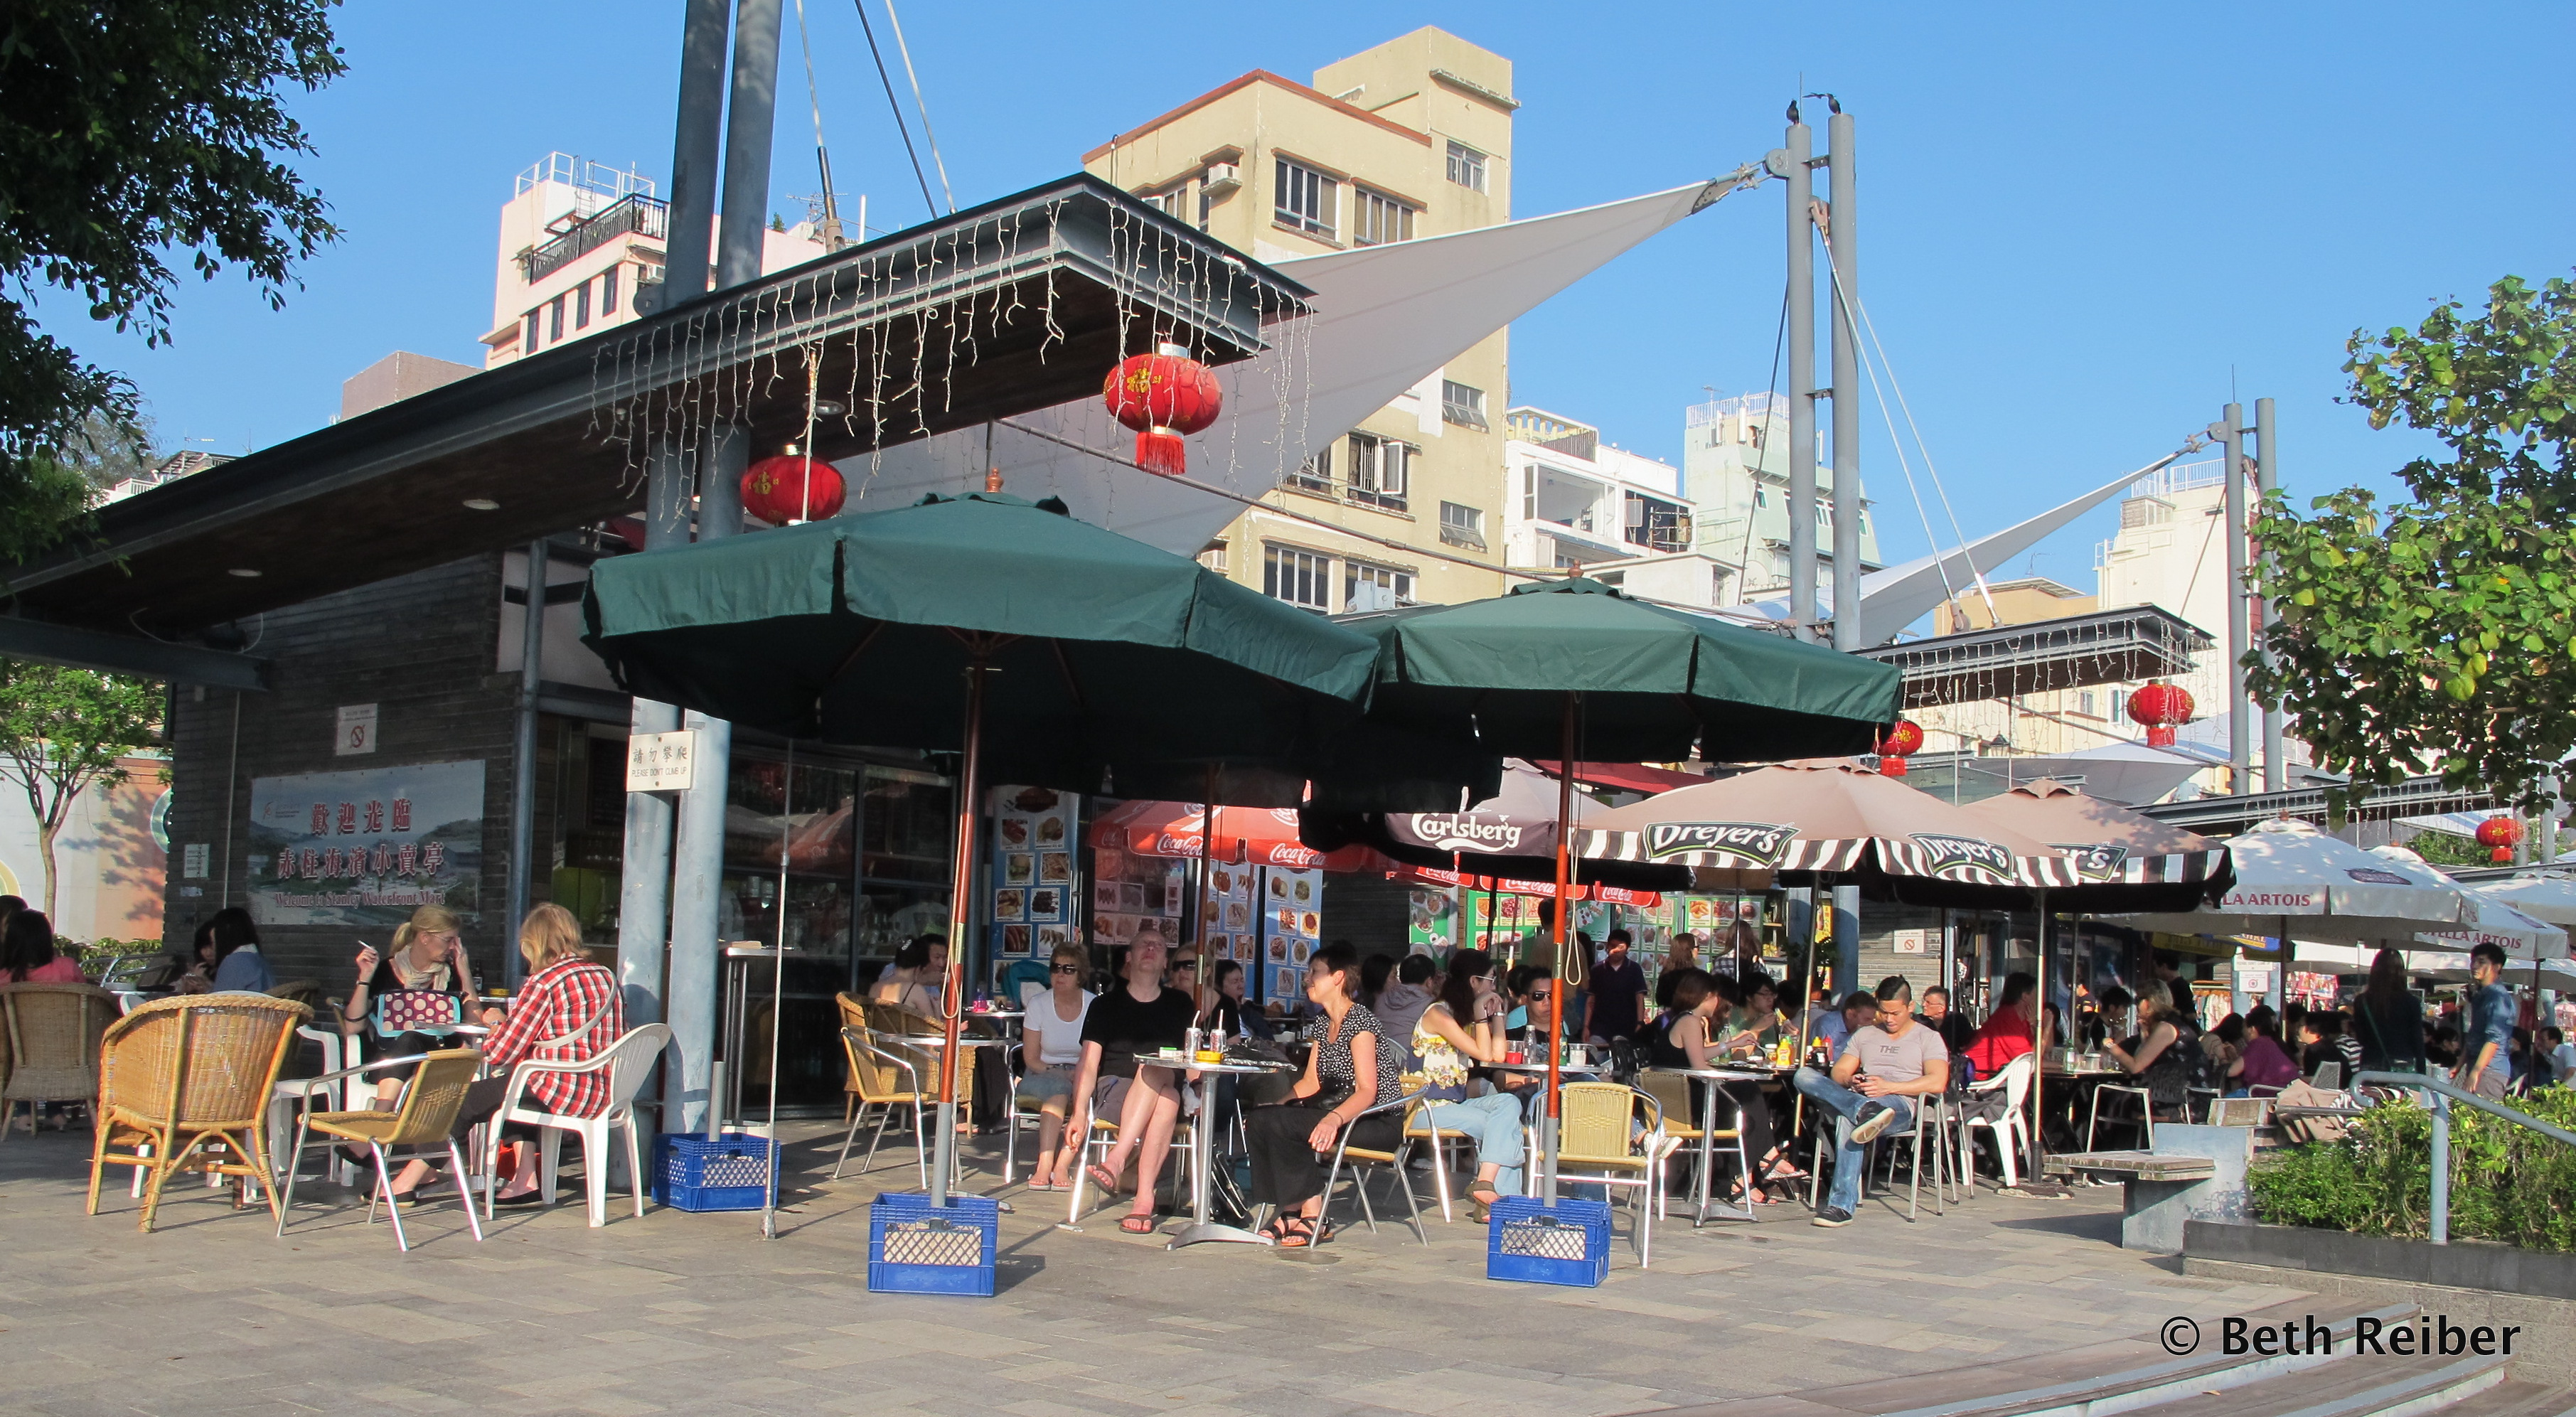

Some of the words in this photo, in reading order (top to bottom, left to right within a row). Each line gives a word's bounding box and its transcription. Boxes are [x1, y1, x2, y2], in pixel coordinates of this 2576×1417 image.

[633, 746, 688, 764] 請勿攀爬
[631, 769, 648, 777] PLEASE
[666, 767, 678, 776] CLIMB
[311, 798, 412, 835] 歡迎光臨
[1411, 813, 1522, 851] Carlsberg
[1654, 824, 1783, 853] Dreyer's
[1157, 833, 1204, 855] Coca-Col
[1269, 843, 1326, 865] Coca-Cola
[1917, 837, 2007, 868] Dreyer's
[278, 841, 445, 879] 赤柱海濱小賣亭
[274, 892, 314, 907] Welcome
[314, 893, 326, 907] to
[326, 890, 361, 909] Stanley
[361, 890, 417, 906] Waterfront
[2248, 893, 2311, 907] ARTOIS
[1879, 1045, 1901, 1054] THE
